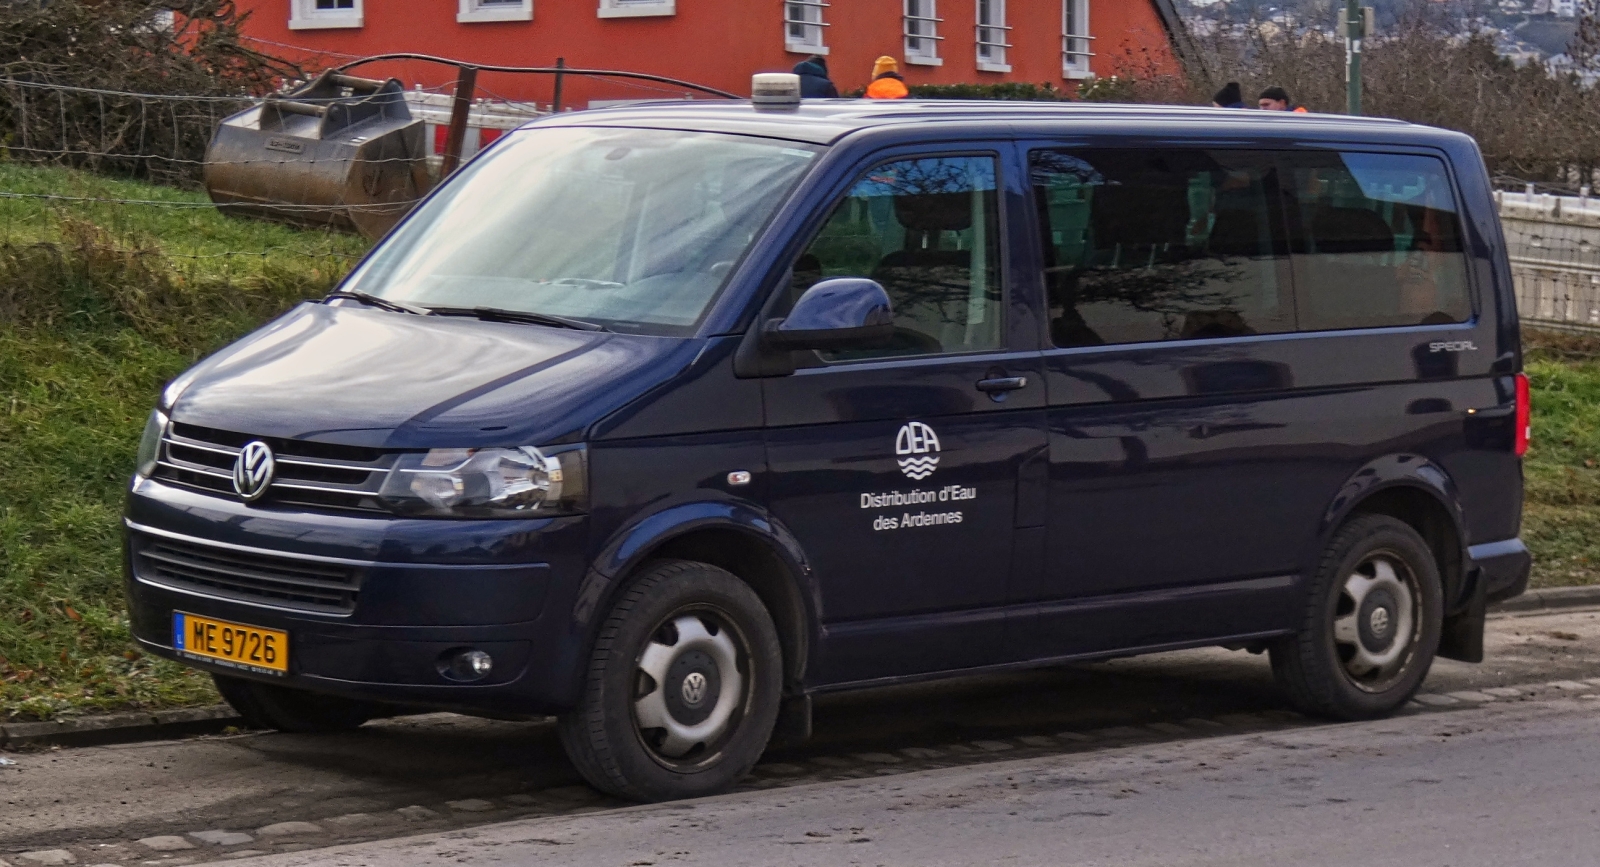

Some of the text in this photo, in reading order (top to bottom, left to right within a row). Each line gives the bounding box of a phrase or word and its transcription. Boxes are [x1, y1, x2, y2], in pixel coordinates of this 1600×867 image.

[1429, 341, 1478, 352] SPECIAL
[895, 421, 941, 455] DEA
[860, 485, 977, 509] Distribution d'Eau
[873, 511, 963, 531] des Ardennes
[193, 620, 276, 664] ME 9726
